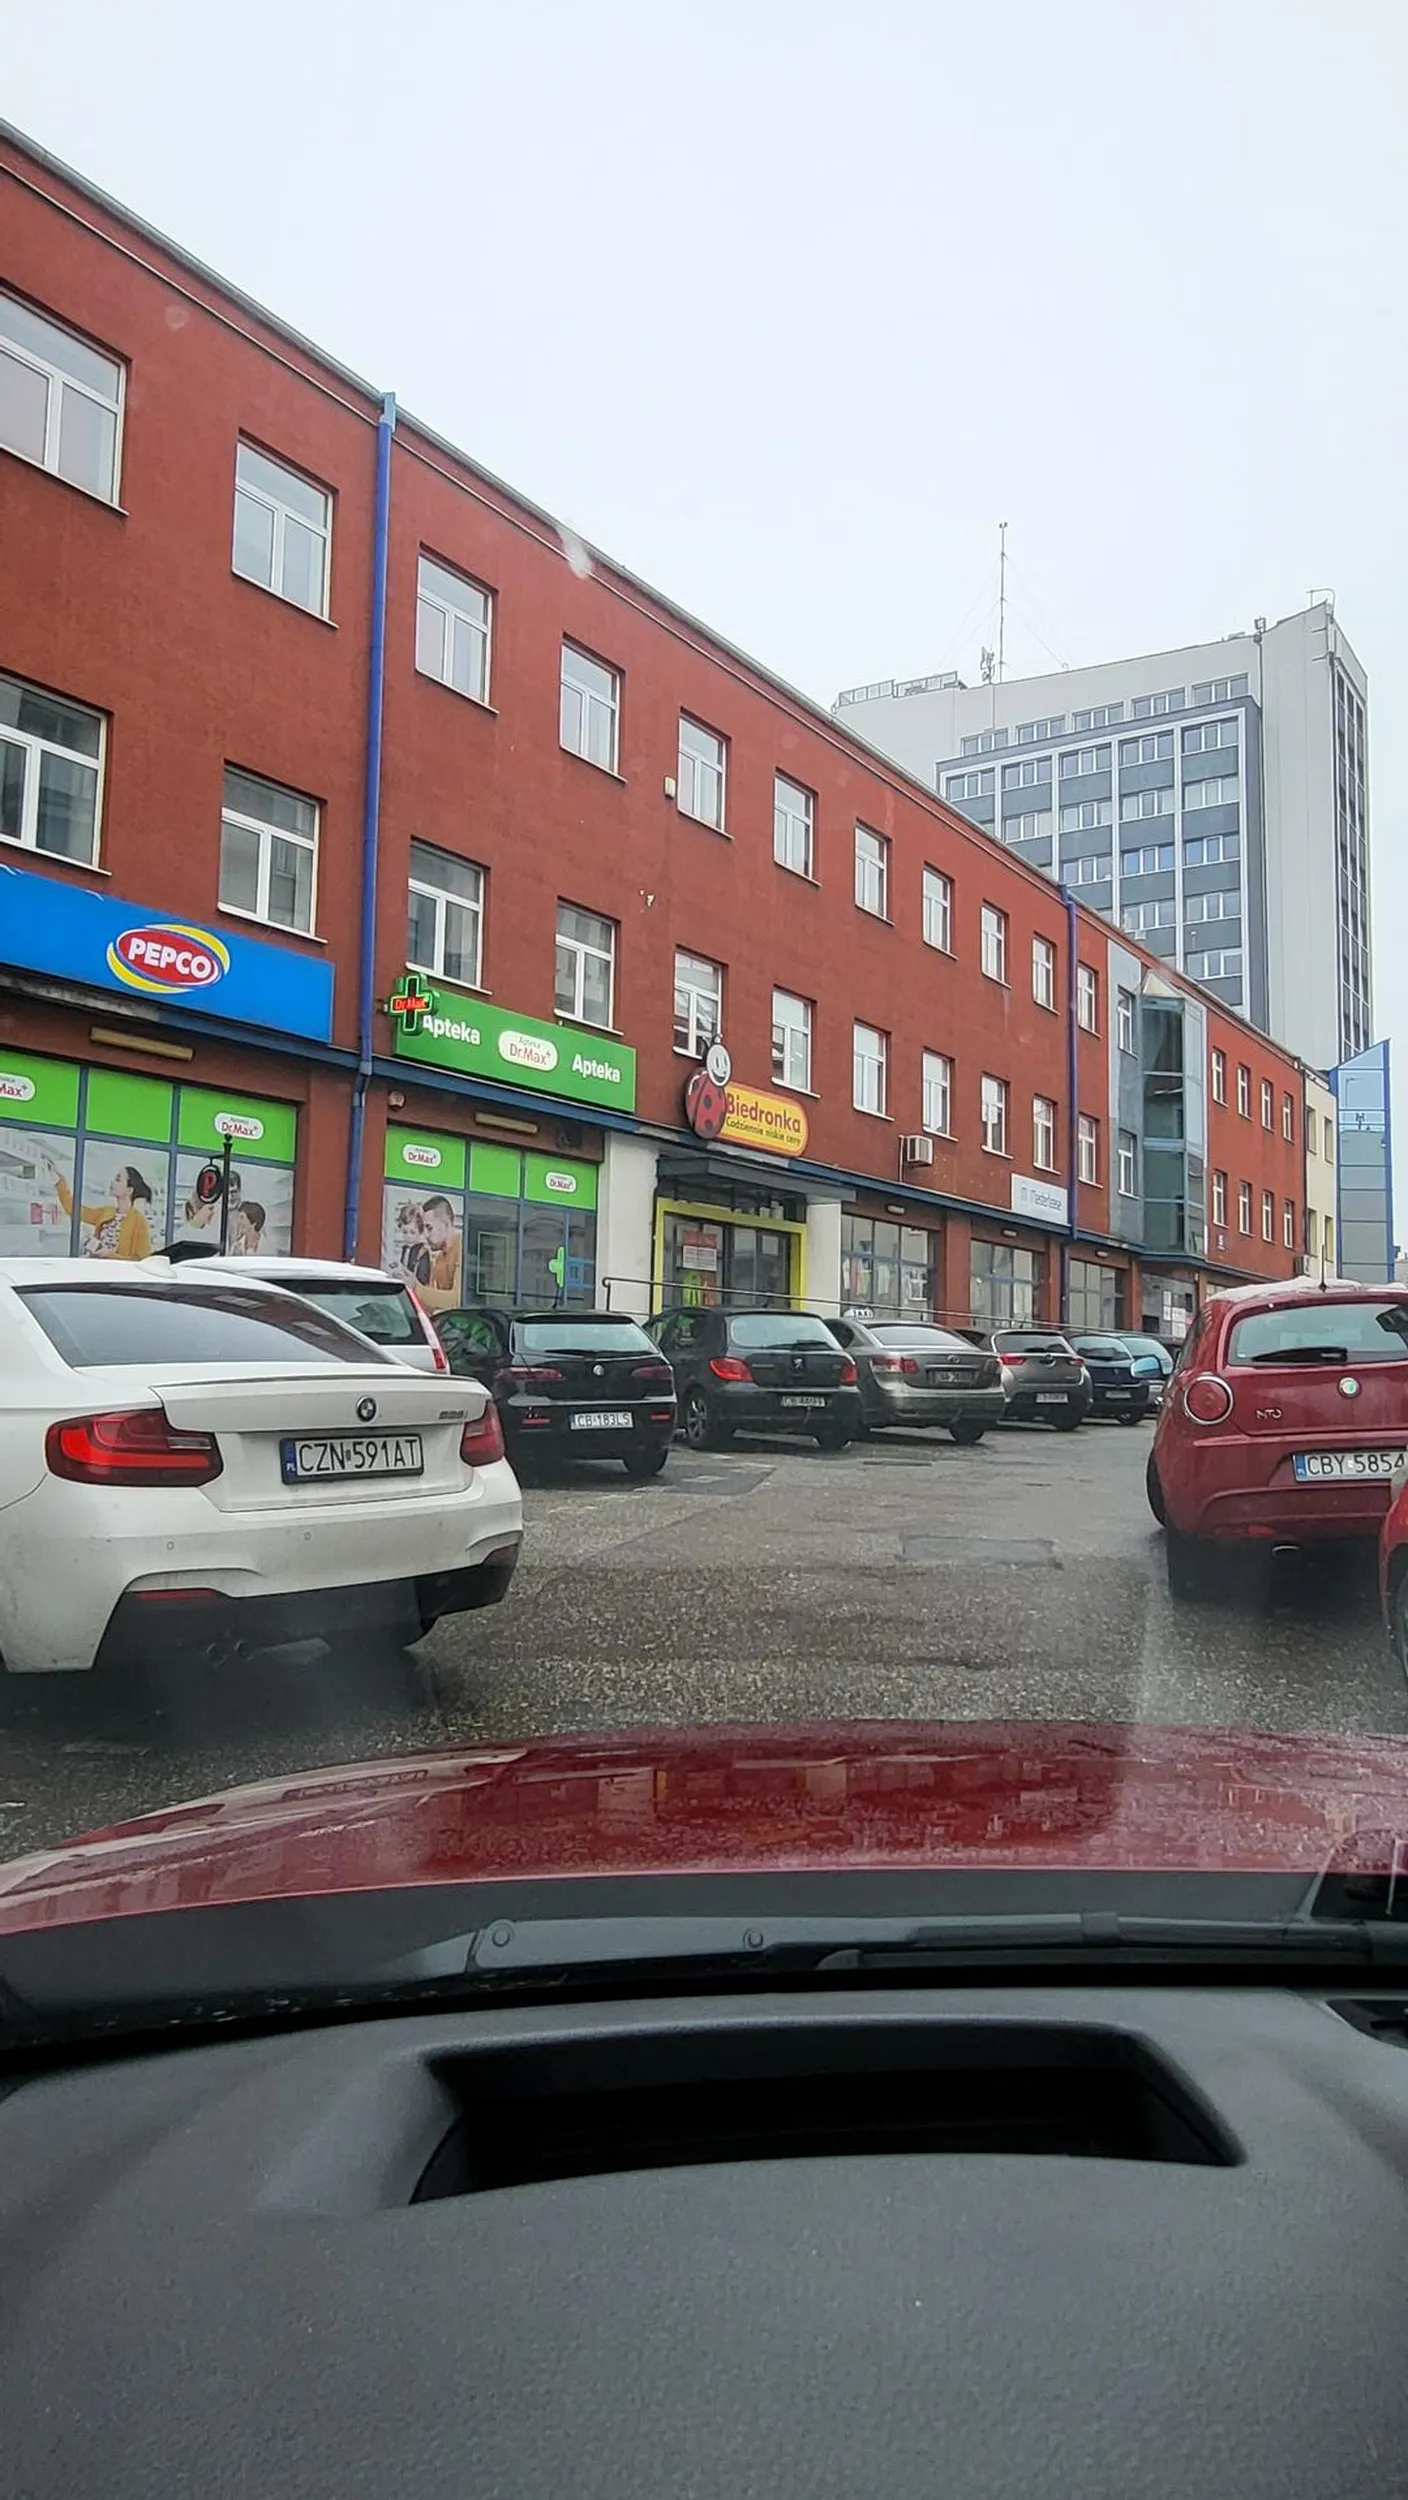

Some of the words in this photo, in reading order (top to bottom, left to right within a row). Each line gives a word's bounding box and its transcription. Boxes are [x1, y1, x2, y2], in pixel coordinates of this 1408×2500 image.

[128, 937, 212, 979] PEPCO
[423, 1015, 481, 1045] Apteka
[572, 1053, 621, 1083] Apteka
[726, 1093, 801, 1133] Biedronka
[577, 1415, 593, 1427] CB
[299, 1443, 346, 1472] CZN
[353, 1439, 417, 1469] 591AT
[1307, 1455, 1346, 1476] CBY
